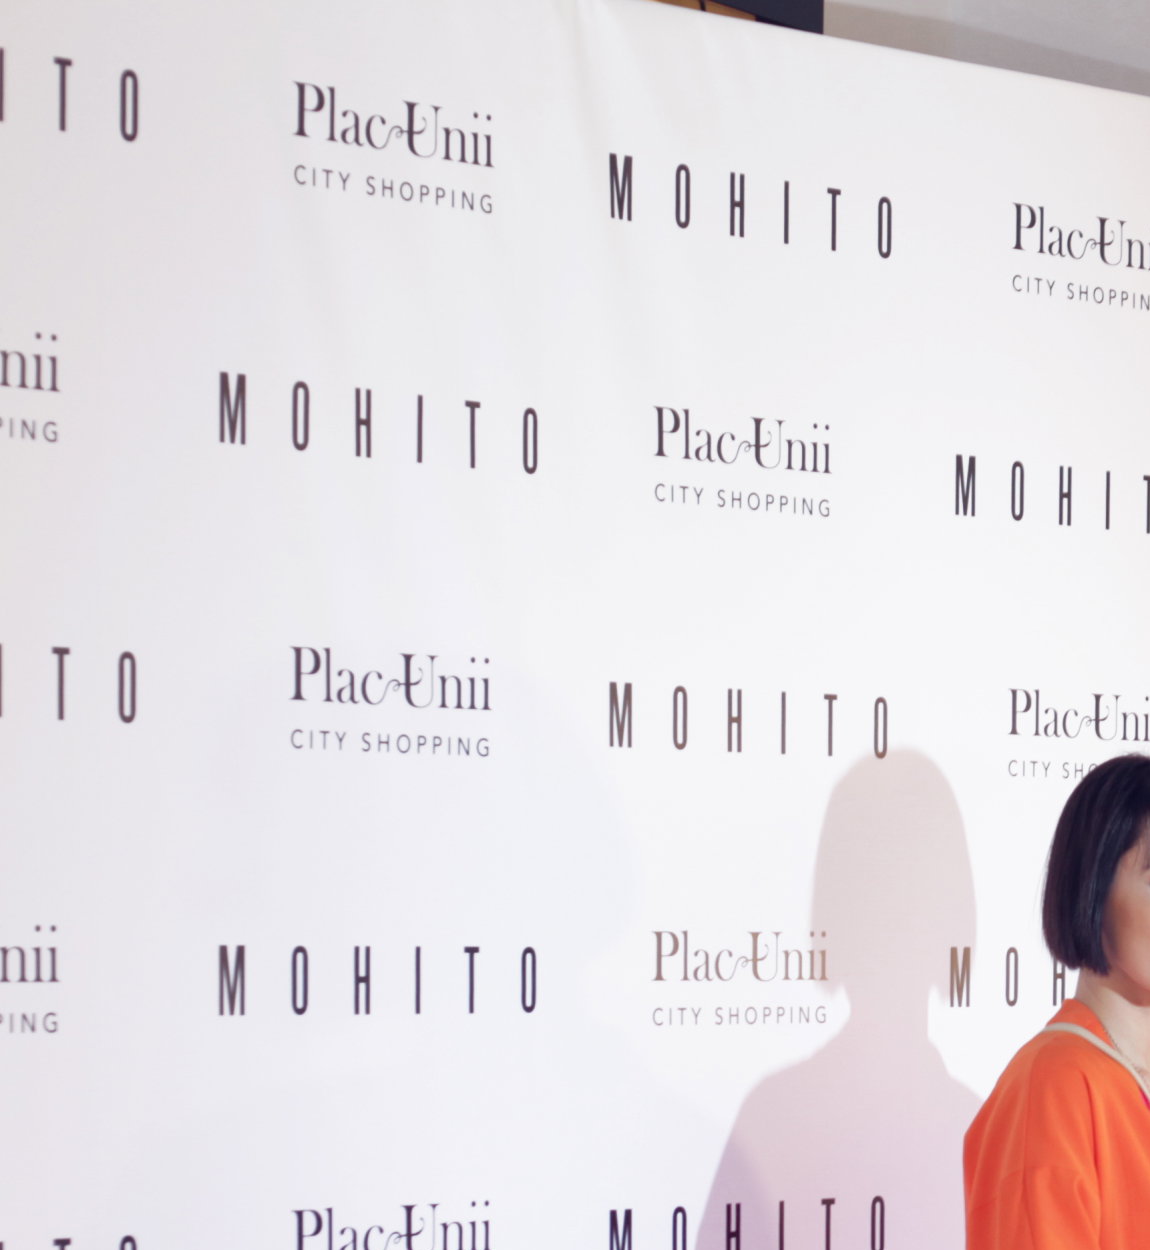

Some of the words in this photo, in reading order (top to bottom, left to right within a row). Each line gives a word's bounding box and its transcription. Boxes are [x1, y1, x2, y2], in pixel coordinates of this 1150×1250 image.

[294, 164, 350, 191] CITY
[366, 176, 492, 214] SHOPPING
[609, 153, 892, 259] MOHITO
[1012, 275, 1055, 296] CITY
[0, 417, 58, 443] ING
[219, 371, 538, 474] MOHITO
[655, 483, 703, 504] CITY
[717, 489, 830, 517] SHOPPING
[609, 681, 887, 760] MOHITO
[291, 729, 346, 750] CITY
[362, 732, 489, 757] SHOPPING
[1008, 760, 1051, 777] CITY
[219, 945, 536, 1016] MOHITO
[950, 946, 1066, 1007] MOH
[0, 1012, 58, 1033] ING
[652, 1007, 701, 1026] CITY
[715, 1005, 826, 1025] SHOPPING
